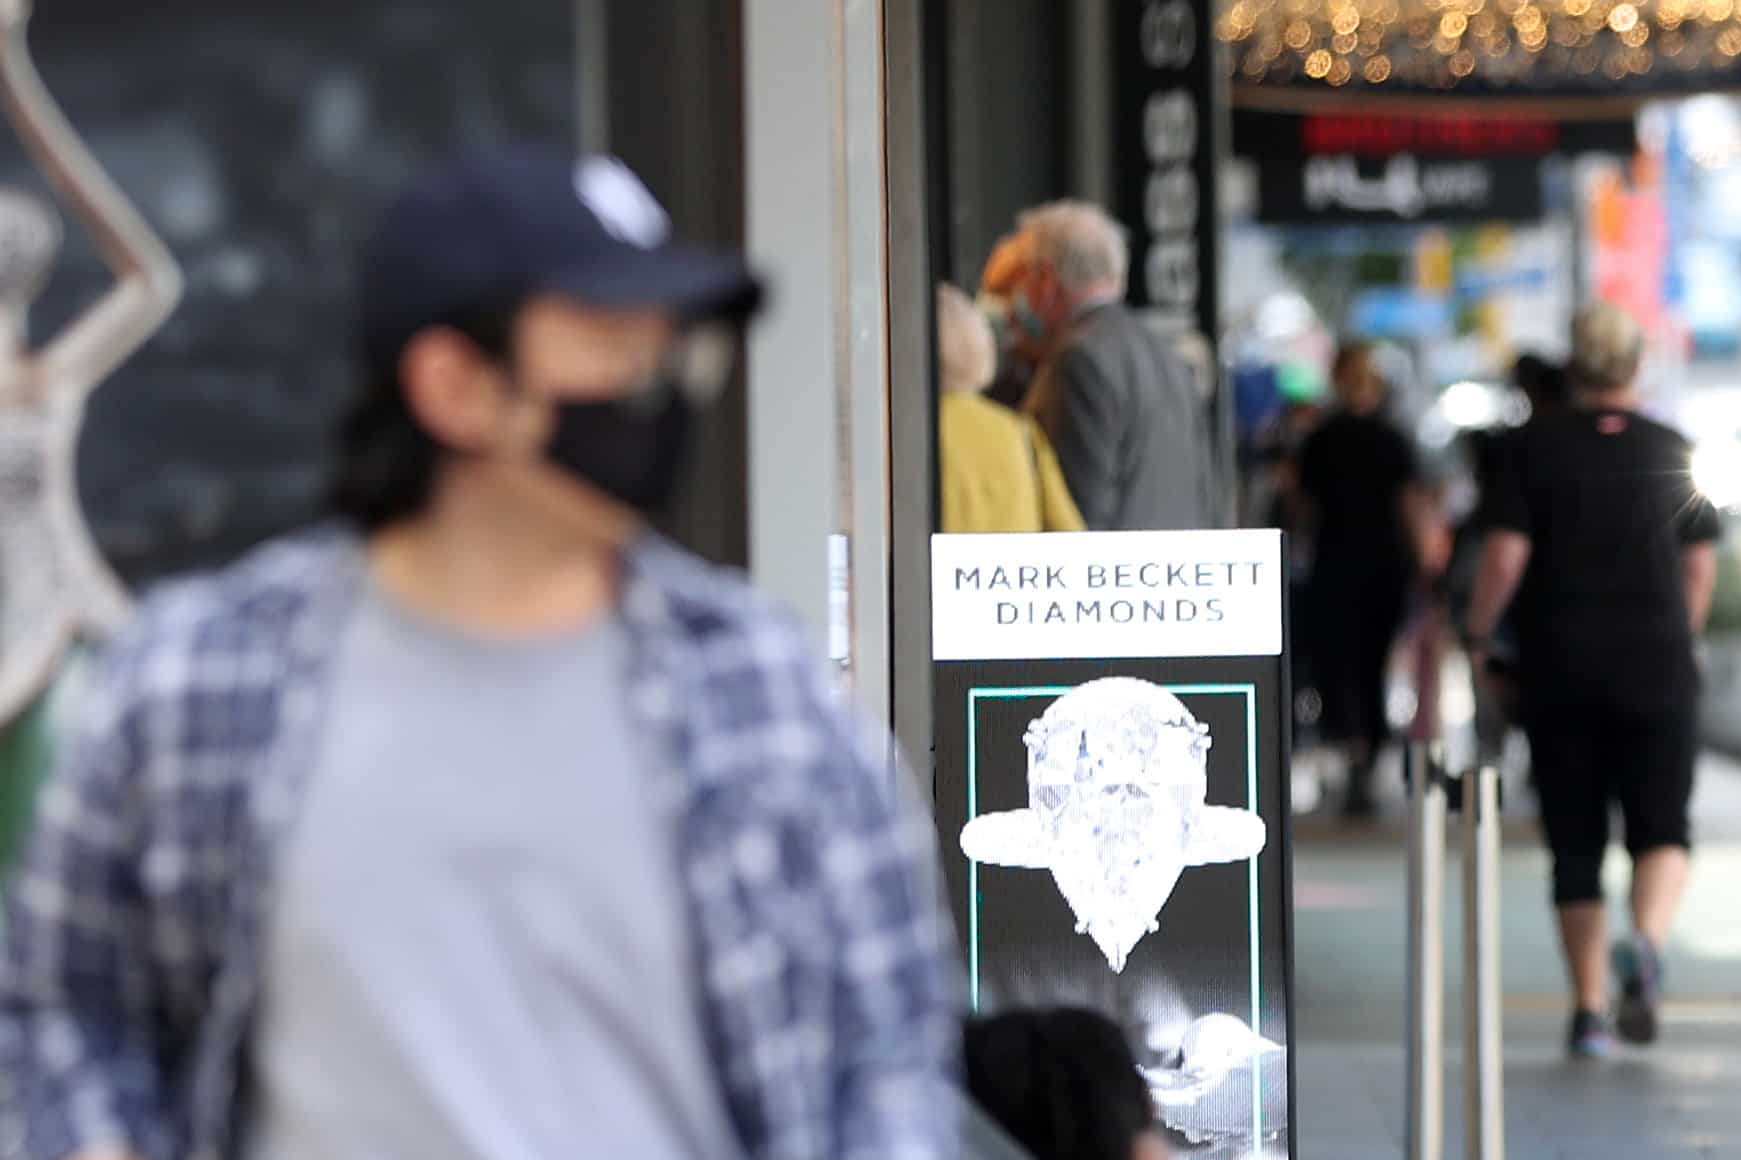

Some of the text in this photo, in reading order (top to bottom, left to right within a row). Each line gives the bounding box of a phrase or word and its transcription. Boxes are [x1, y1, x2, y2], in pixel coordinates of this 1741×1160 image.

[955, 561, 1263, 590] MARK BECKETT
[996, 598, 1224, 625] DIAMONDS
